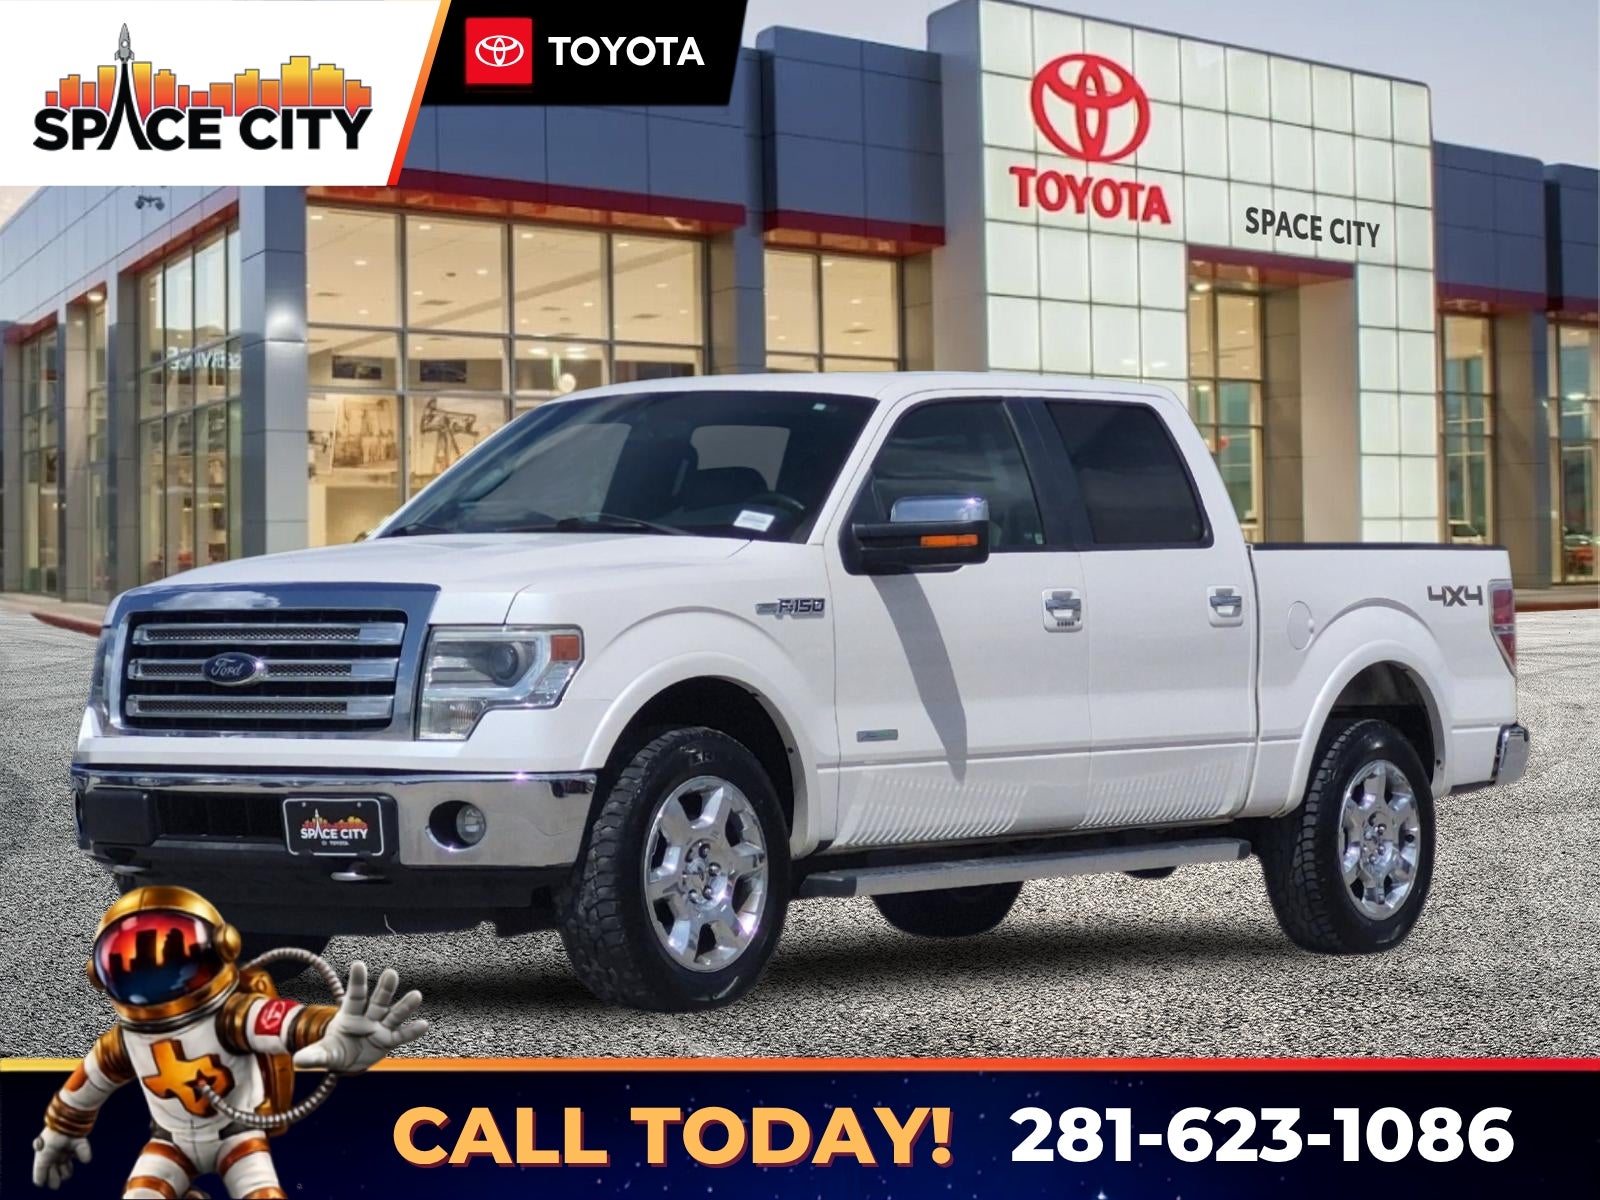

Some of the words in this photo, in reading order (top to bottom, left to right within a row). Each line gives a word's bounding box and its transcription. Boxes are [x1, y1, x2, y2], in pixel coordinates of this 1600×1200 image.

[1009, 166, 1171, 224] TOYOTA
[1245, 207, 1322, 241] SPACE
[1330, 218, 1380, 248] CITY
[211, 657, 244, 676] Ford
[300, 827, 338, 839] SPACE
[340, 828, 368, 840] CITY
